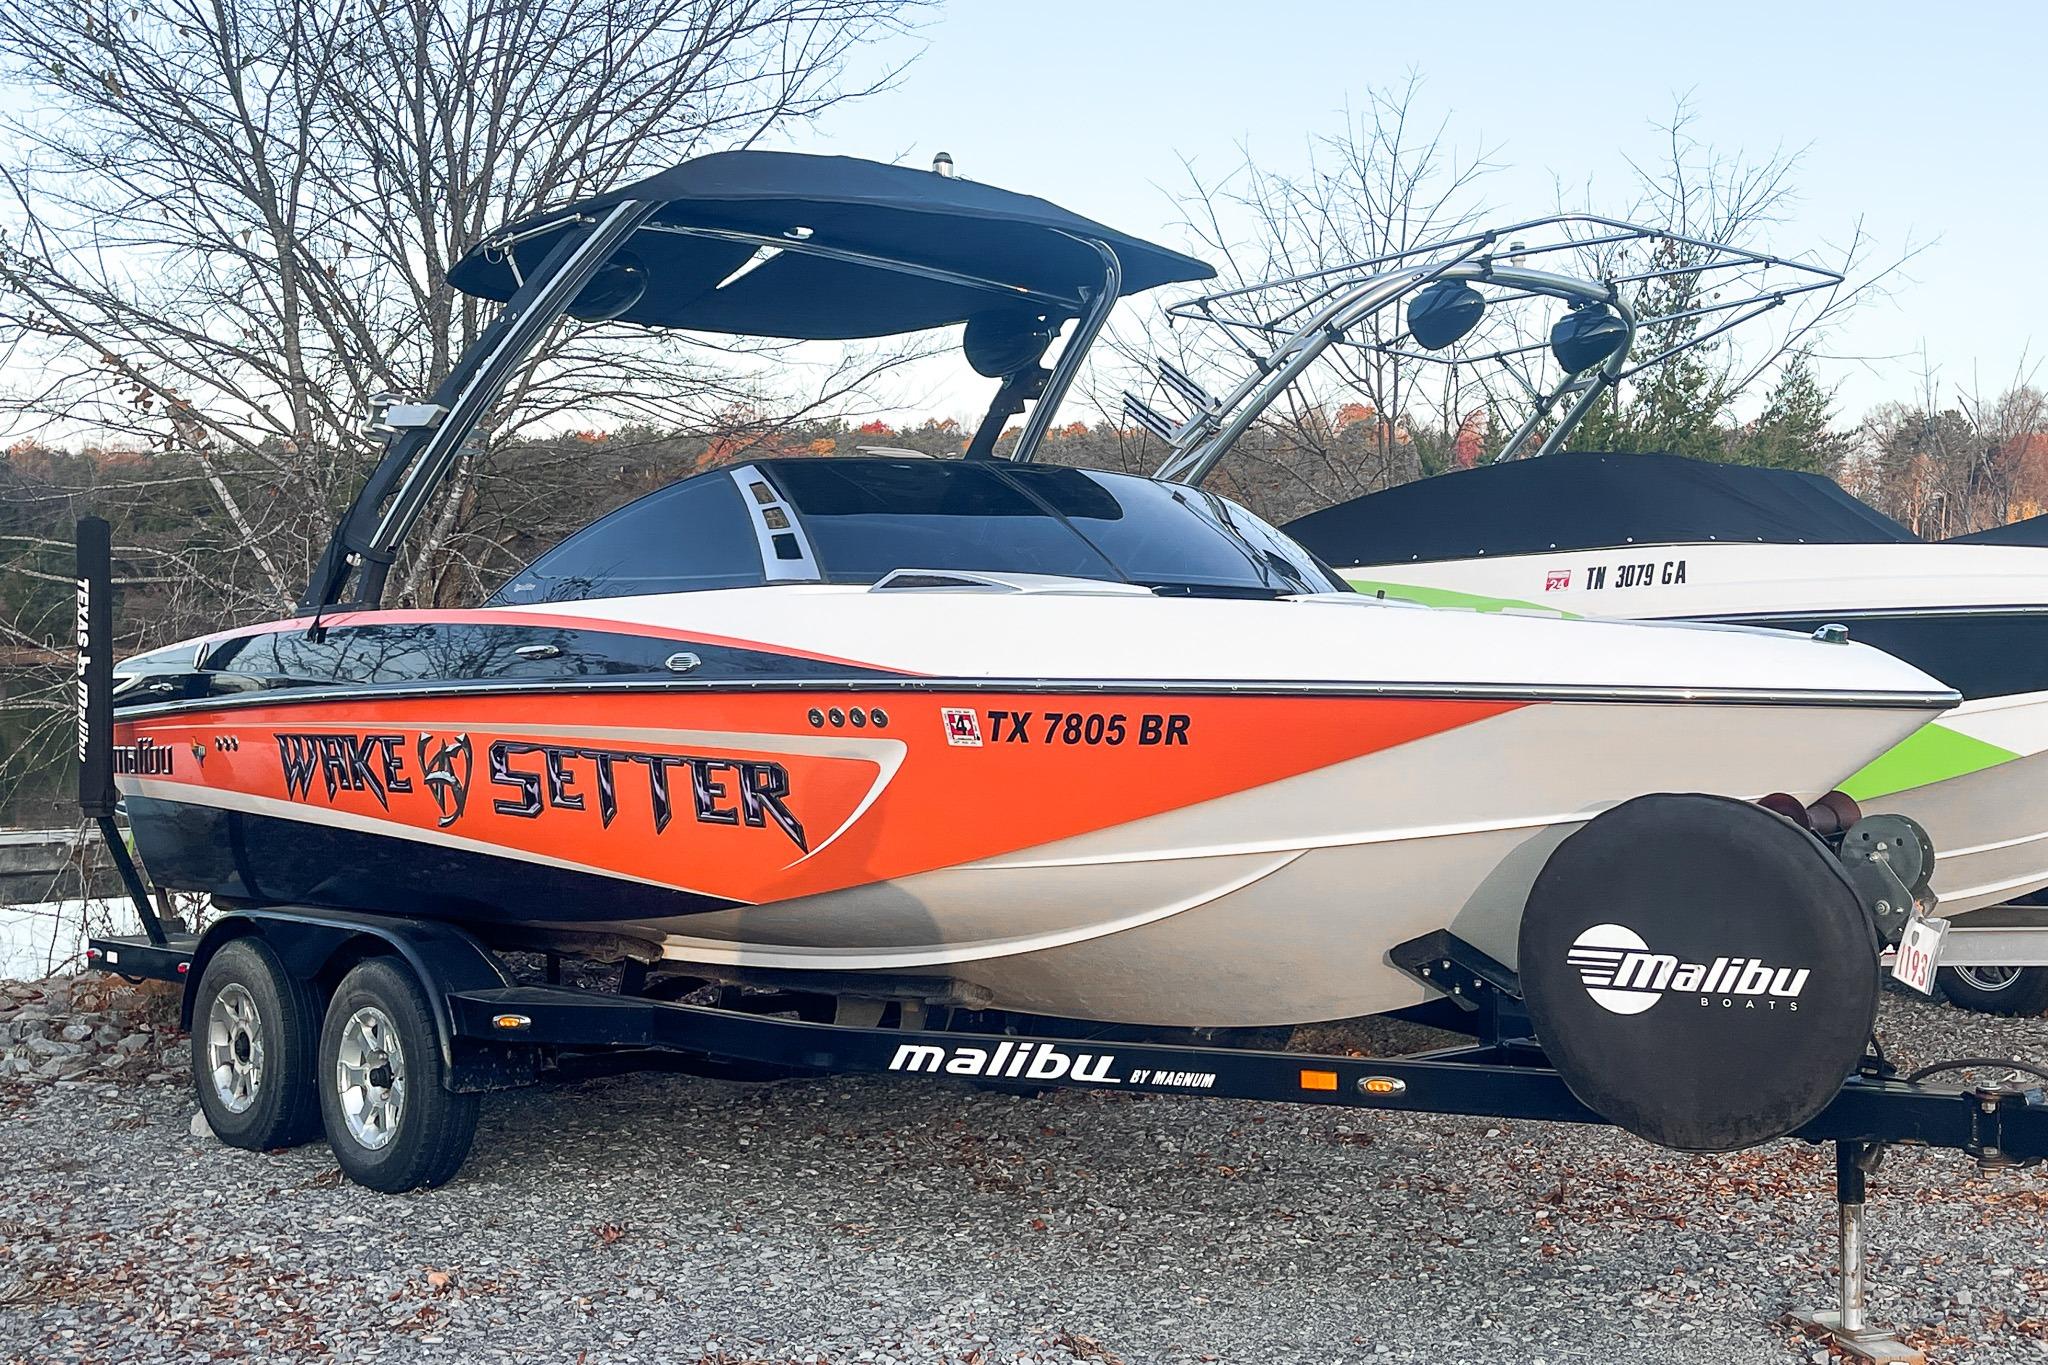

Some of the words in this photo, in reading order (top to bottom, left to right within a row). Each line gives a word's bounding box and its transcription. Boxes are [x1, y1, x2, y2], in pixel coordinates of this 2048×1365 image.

[1549, 579, 1569, 591] 24
[1586, 566, 1607, 590] TN
[1615, 563, 1655, 588] 3079
[1661, 560, 1686, 585] GA
[77, 578, 90, 647] TEXAS
[956, 714, 968, 735] 4
[987, 710, 1032, 743] TX
[1044, 713, 1127, 746] 7805
[1138, 714, 1191, 746] BR
[274, 733, 413, 813] WAKE
[489, 739, 810, 855] SETTER
[1898, 943, 1928, 987] 1193
[1700, 997, 1798, 1012] BOATS
[888, 1041, 1121, 1084] malibu
[1129, 1069, 1151, 1084] BY
[1151, 1070, 1216, 1088] MAGNUM
